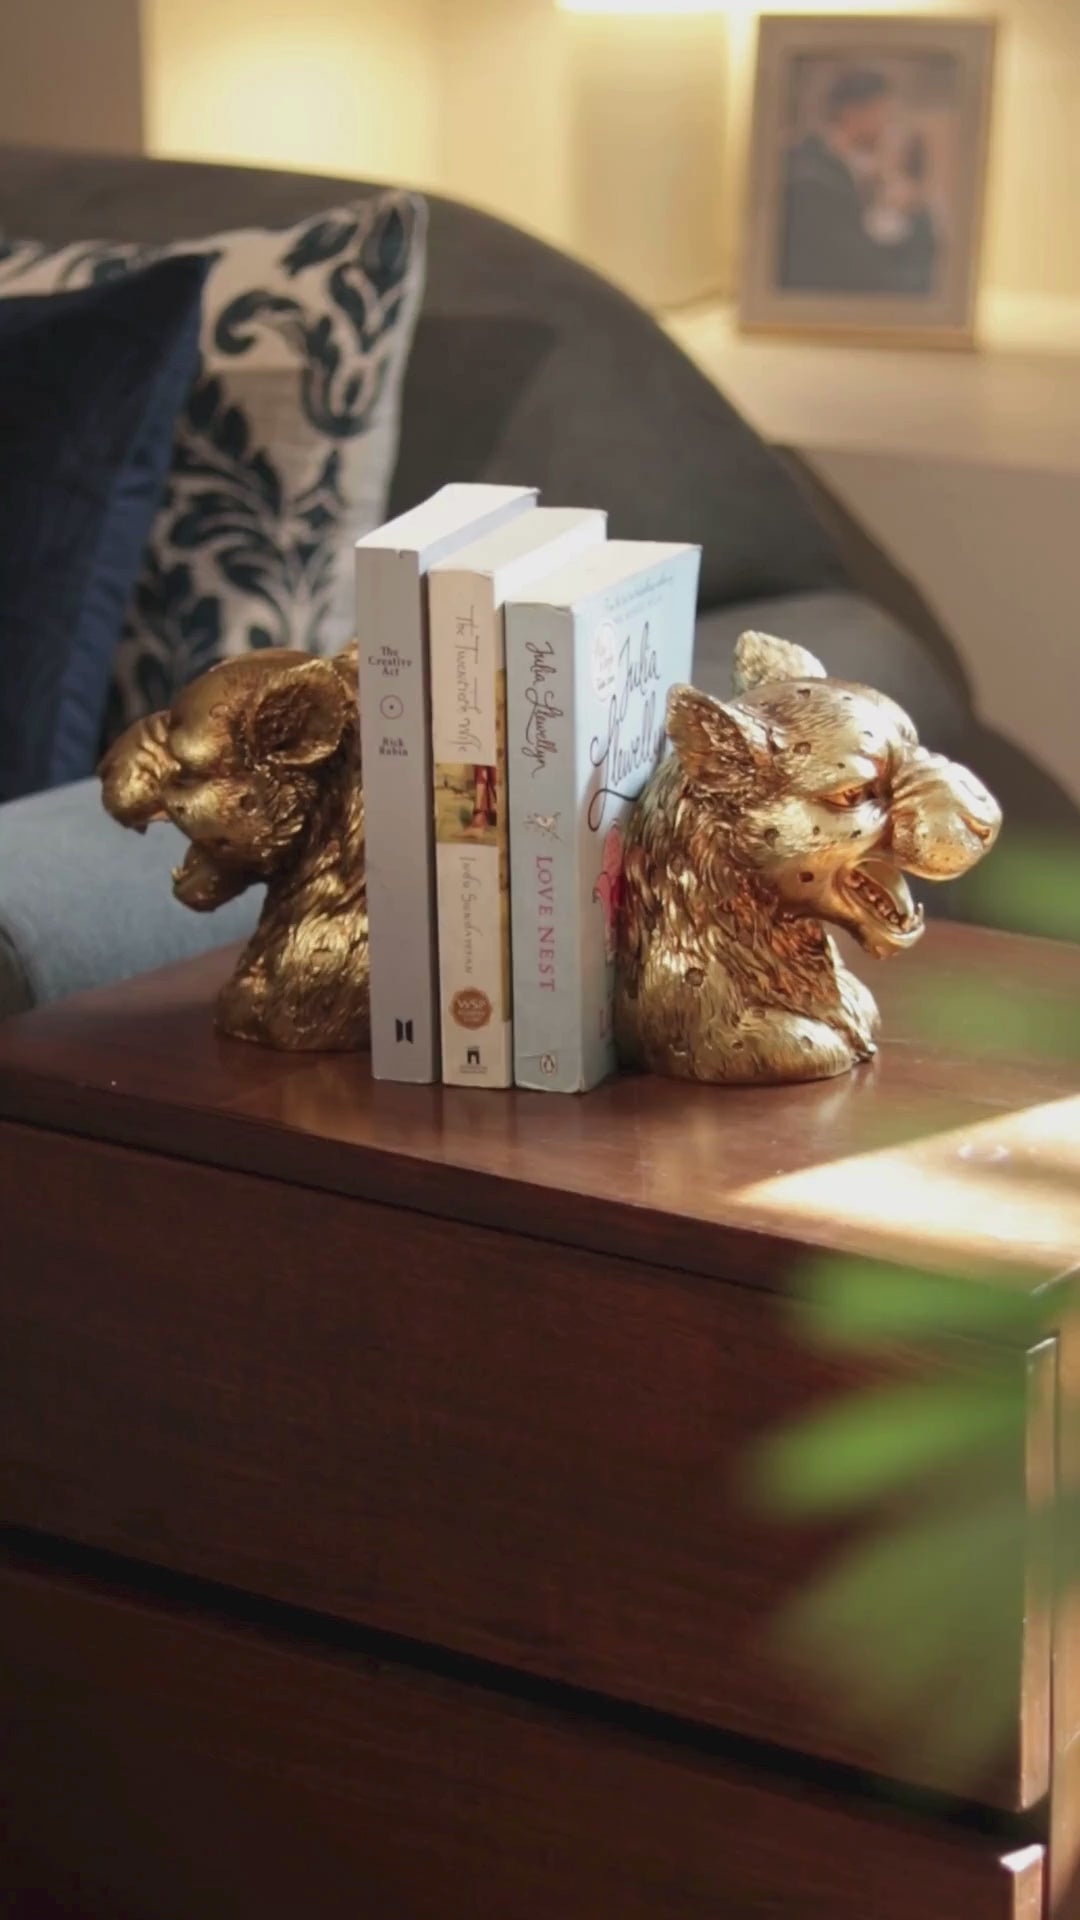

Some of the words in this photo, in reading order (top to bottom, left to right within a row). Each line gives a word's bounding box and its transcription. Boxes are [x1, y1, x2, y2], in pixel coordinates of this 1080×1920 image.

[368, 655, 412, 667] Creative
[380, 645, 399, 656] The
[525, 641, 557, 687] Julia
[382, 667, 399, 677] Act
[618, 621, 661, 721] Julia
[382, 735, 404, 747] Rick
[521, 687, 564, 779] Llewellyn
[379, 745, 409, 757] Rubin
[536, 855, 554, 916] LOVE
[538, 925, 555, 993] NEST
